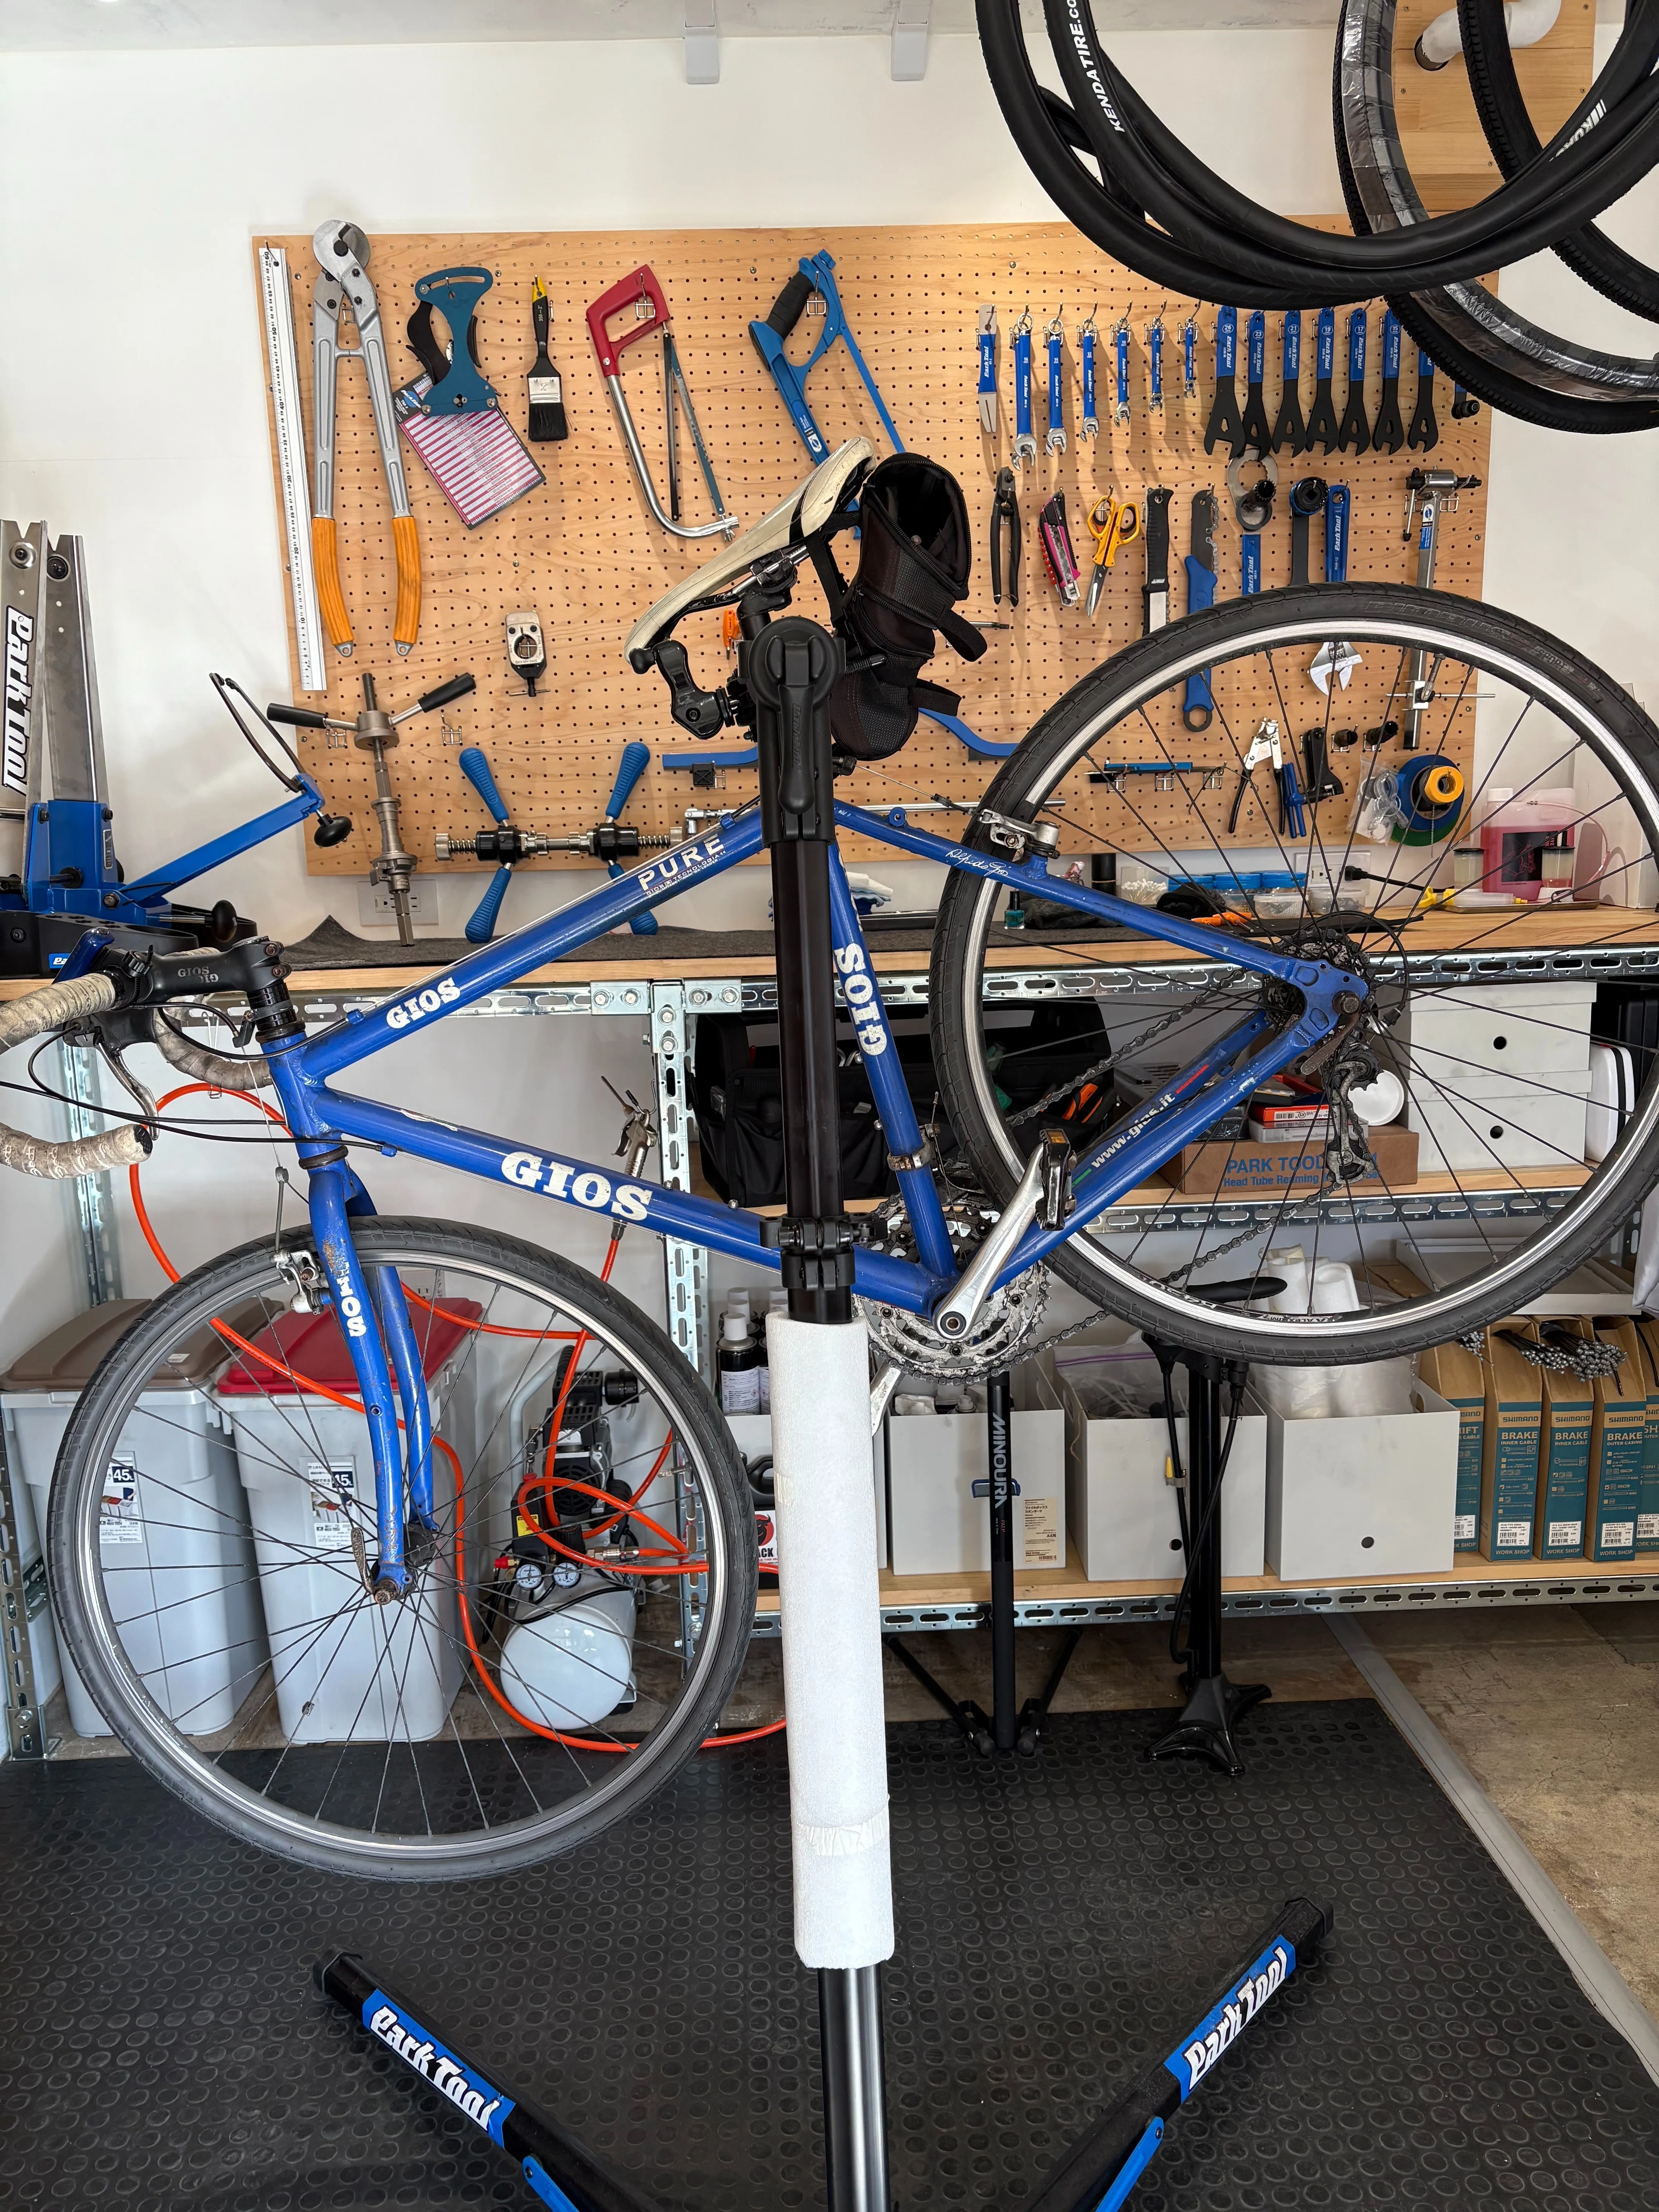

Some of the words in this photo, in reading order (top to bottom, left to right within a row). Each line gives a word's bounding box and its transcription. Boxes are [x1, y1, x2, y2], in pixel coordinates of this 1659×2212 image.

[638, 834, 724, 891] PURE
[178, 966, 210, 977] GIOS
[386, 976, 461, 1029] GIOS
[834, 943, 887, 1056] GIOS
[1091, 1093, 1175, 1168] www.gios.it
[501, 1151, 653, 1221] GIOS
[1224, 1176, 1248, 1187] Head
[1251, 1175, 1273, 1185] Tube
[1277, 1174, 1319, 1185] Reaming
[1226, 1158, 1273, 1174] PARK
[1278, 1155, 1324, 1171] TOOL
[992, 1412, 1007, 1508] MINOURA
[1501, 1431, 1538, 1439] BRAKE
[1555, 1431, 1588, 1440] BRAKE
[1607, 1432, 1642, 1441] BRAKE
[1185, 2002, 1242, 2090] Park
[1237, 1946, 1288, 2017] Tool
[370, 2006, 435, 2076] Park
[432, 2056, 501, 2131] Tool
